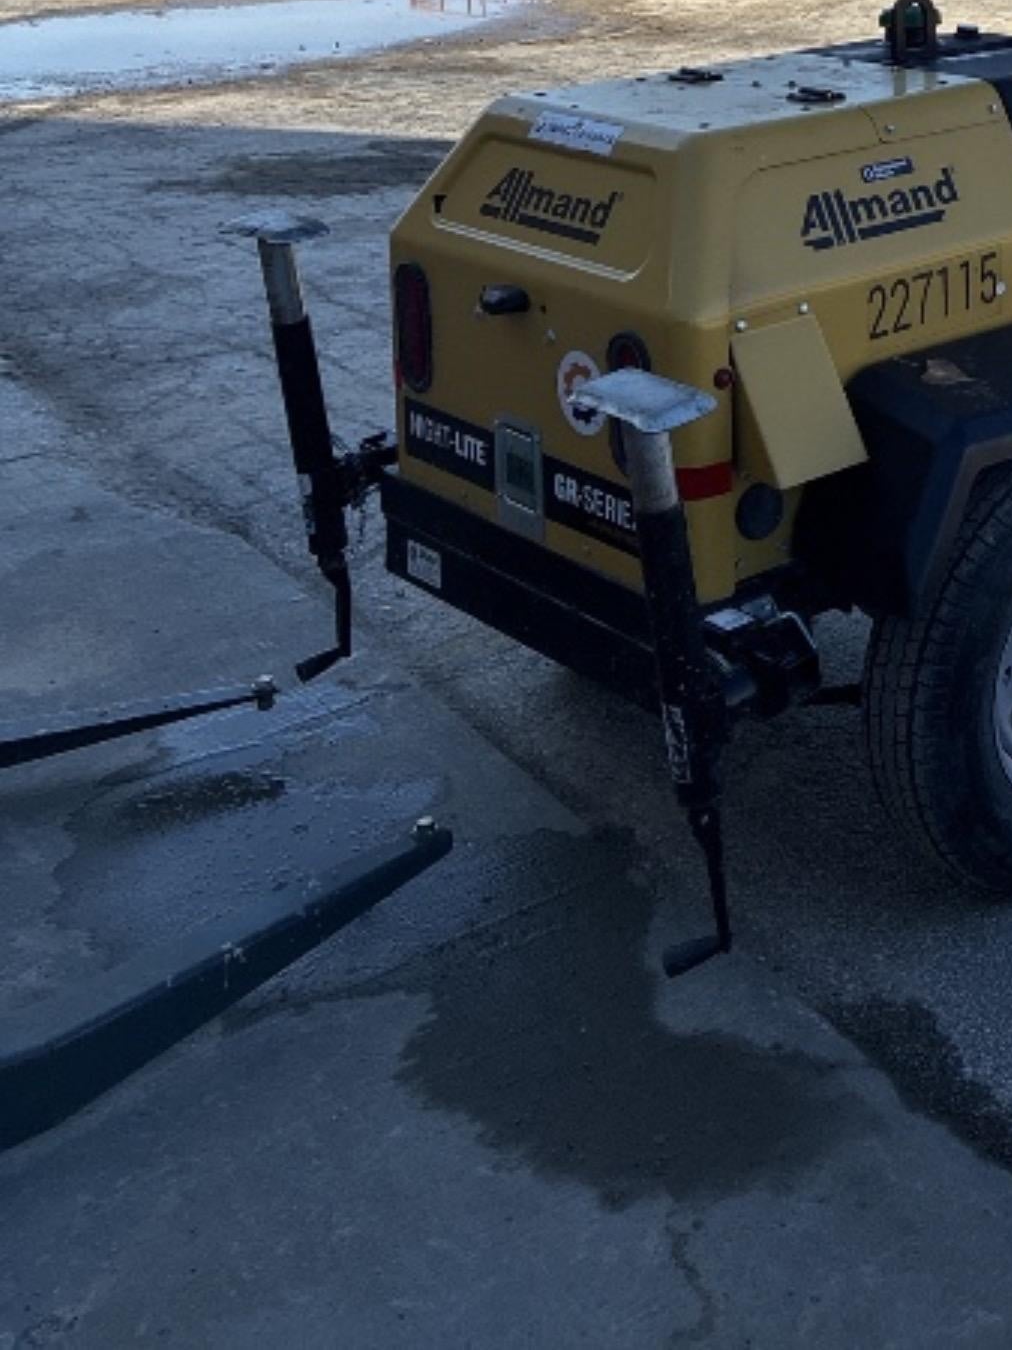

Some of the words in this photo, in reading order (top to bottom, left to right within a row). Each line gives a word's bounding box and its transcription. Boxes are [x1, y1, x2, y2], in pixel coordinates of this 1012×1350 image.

[484, 167, 617, 230] Allmand
[801, 166, 960, 245] Allmand
[867, 251, 999, 341] 227115
[552, 472, 637, 532] GR-SERIE
